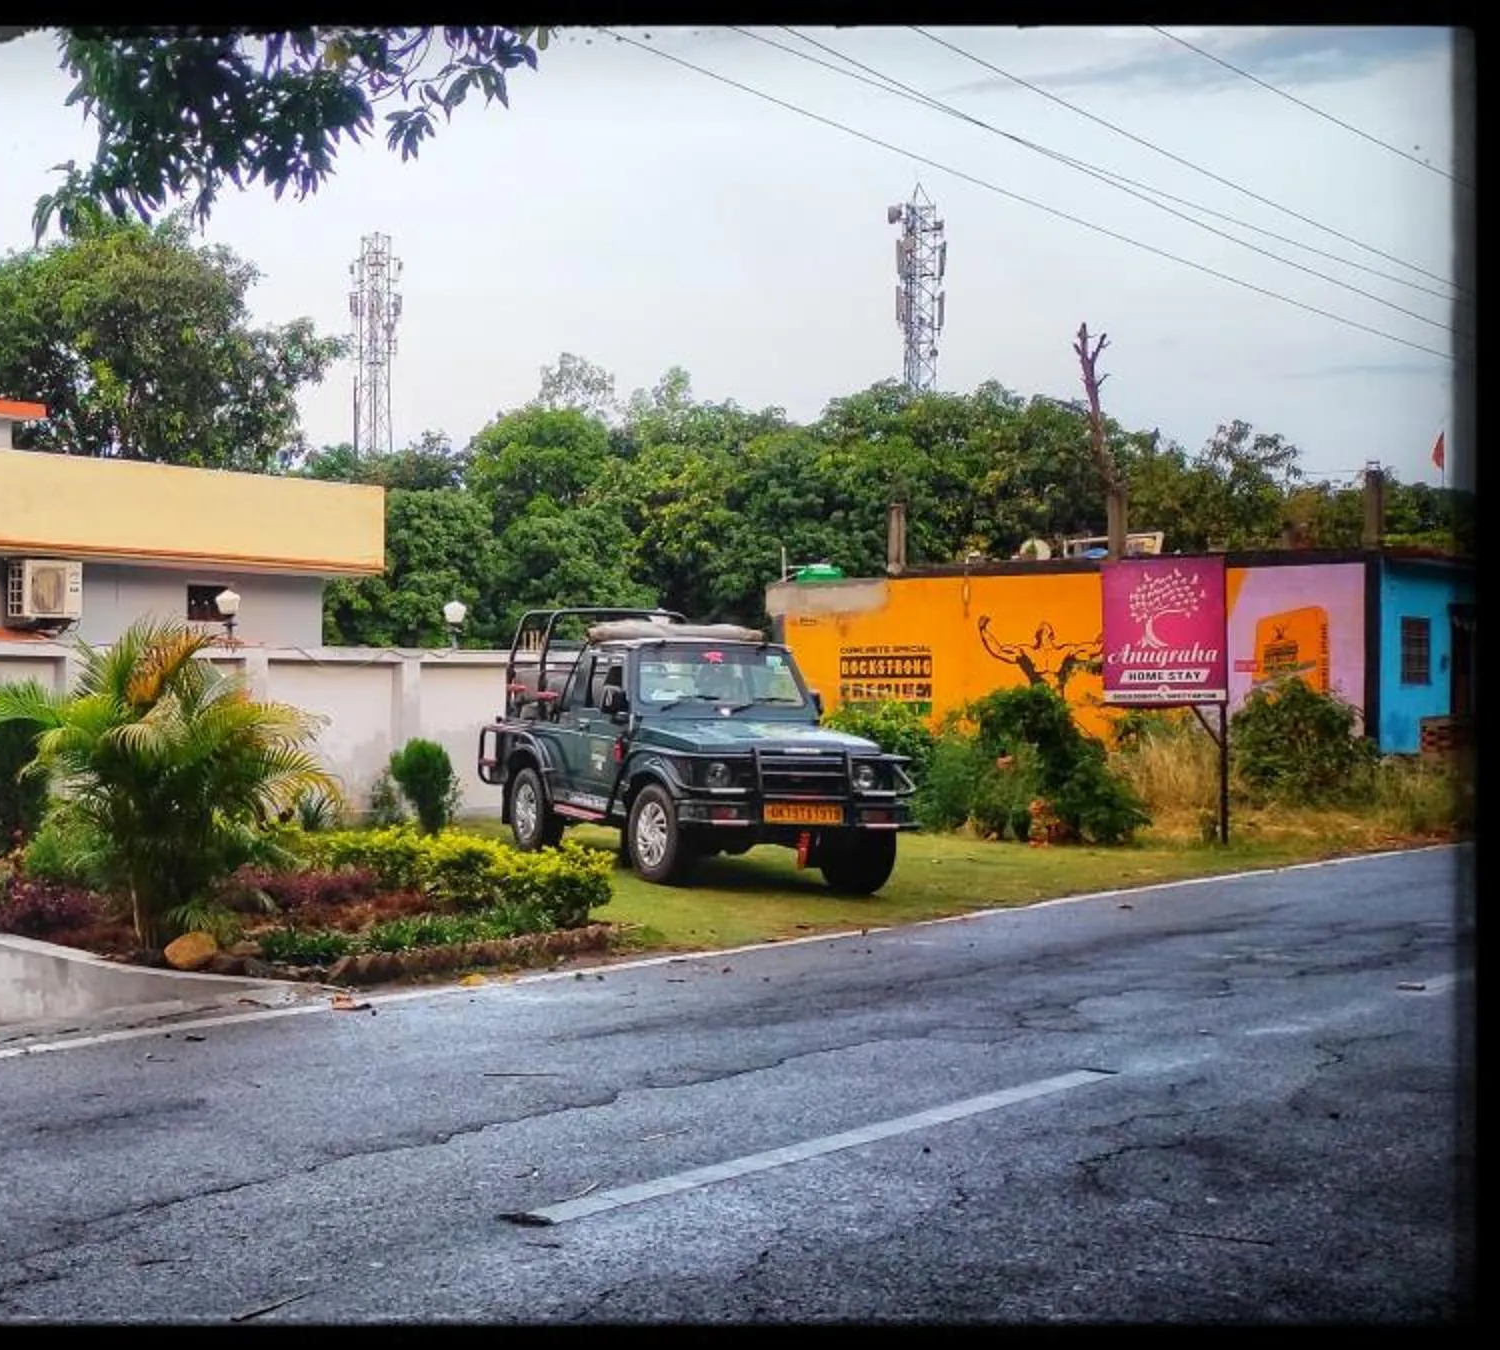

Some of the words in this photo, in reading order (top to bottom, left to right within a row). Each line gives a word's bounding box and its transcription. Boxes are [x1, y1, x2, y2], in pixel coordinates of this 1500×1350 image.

[1107, 642, 1219, 667] Anugraha
[841, 658, 931, 676] ROCKSTRONG
[1128, 671, 1164, 681] HOME
[1167, 671, 1201, 680] STAY
[840, 683, 932, 699] PREMIUM
